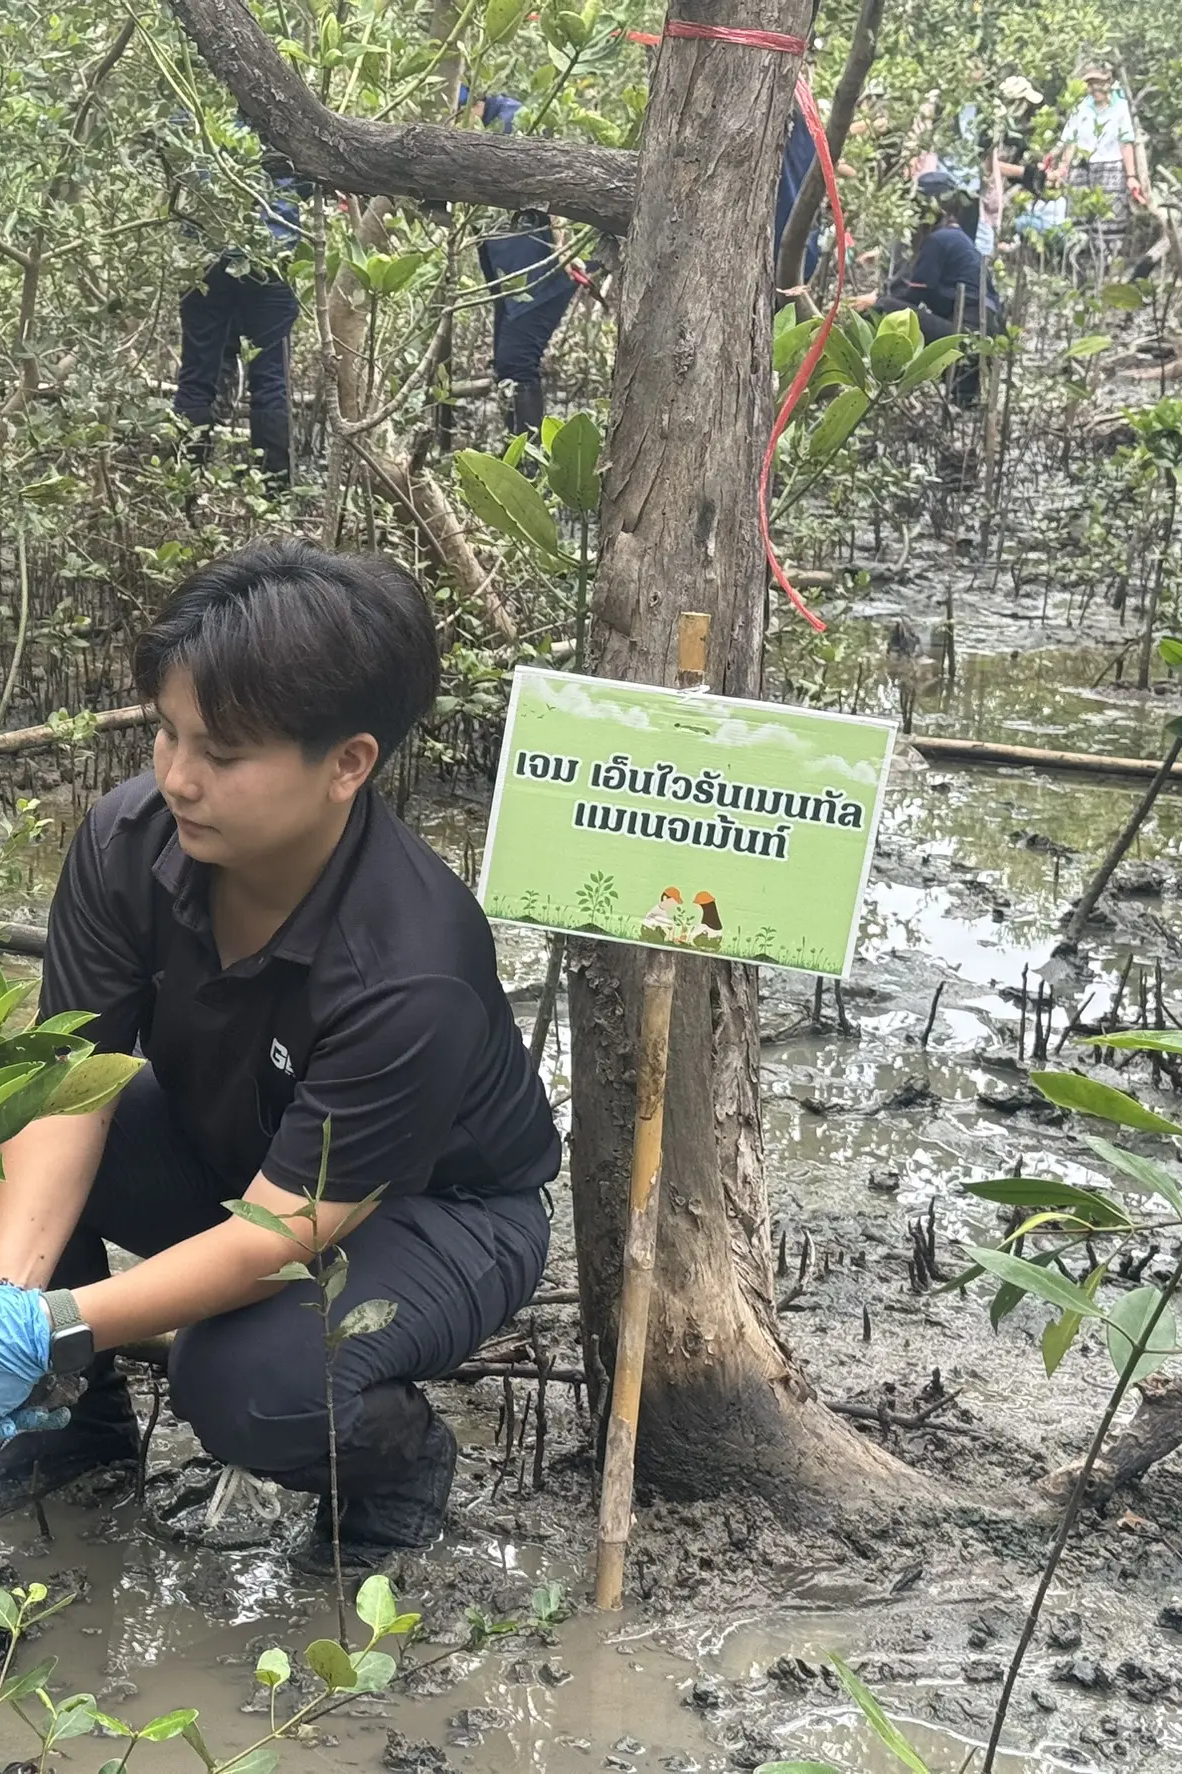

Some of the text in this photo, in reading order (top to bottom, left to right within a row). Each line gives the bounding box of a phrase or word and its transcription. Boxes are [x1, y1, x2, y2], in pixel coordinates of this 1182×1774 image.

[516, 751, 862, 829] เจม เอ็นไวรันเมนทัล
[574, 802, 791, 859] แมเนจเม้นท์
